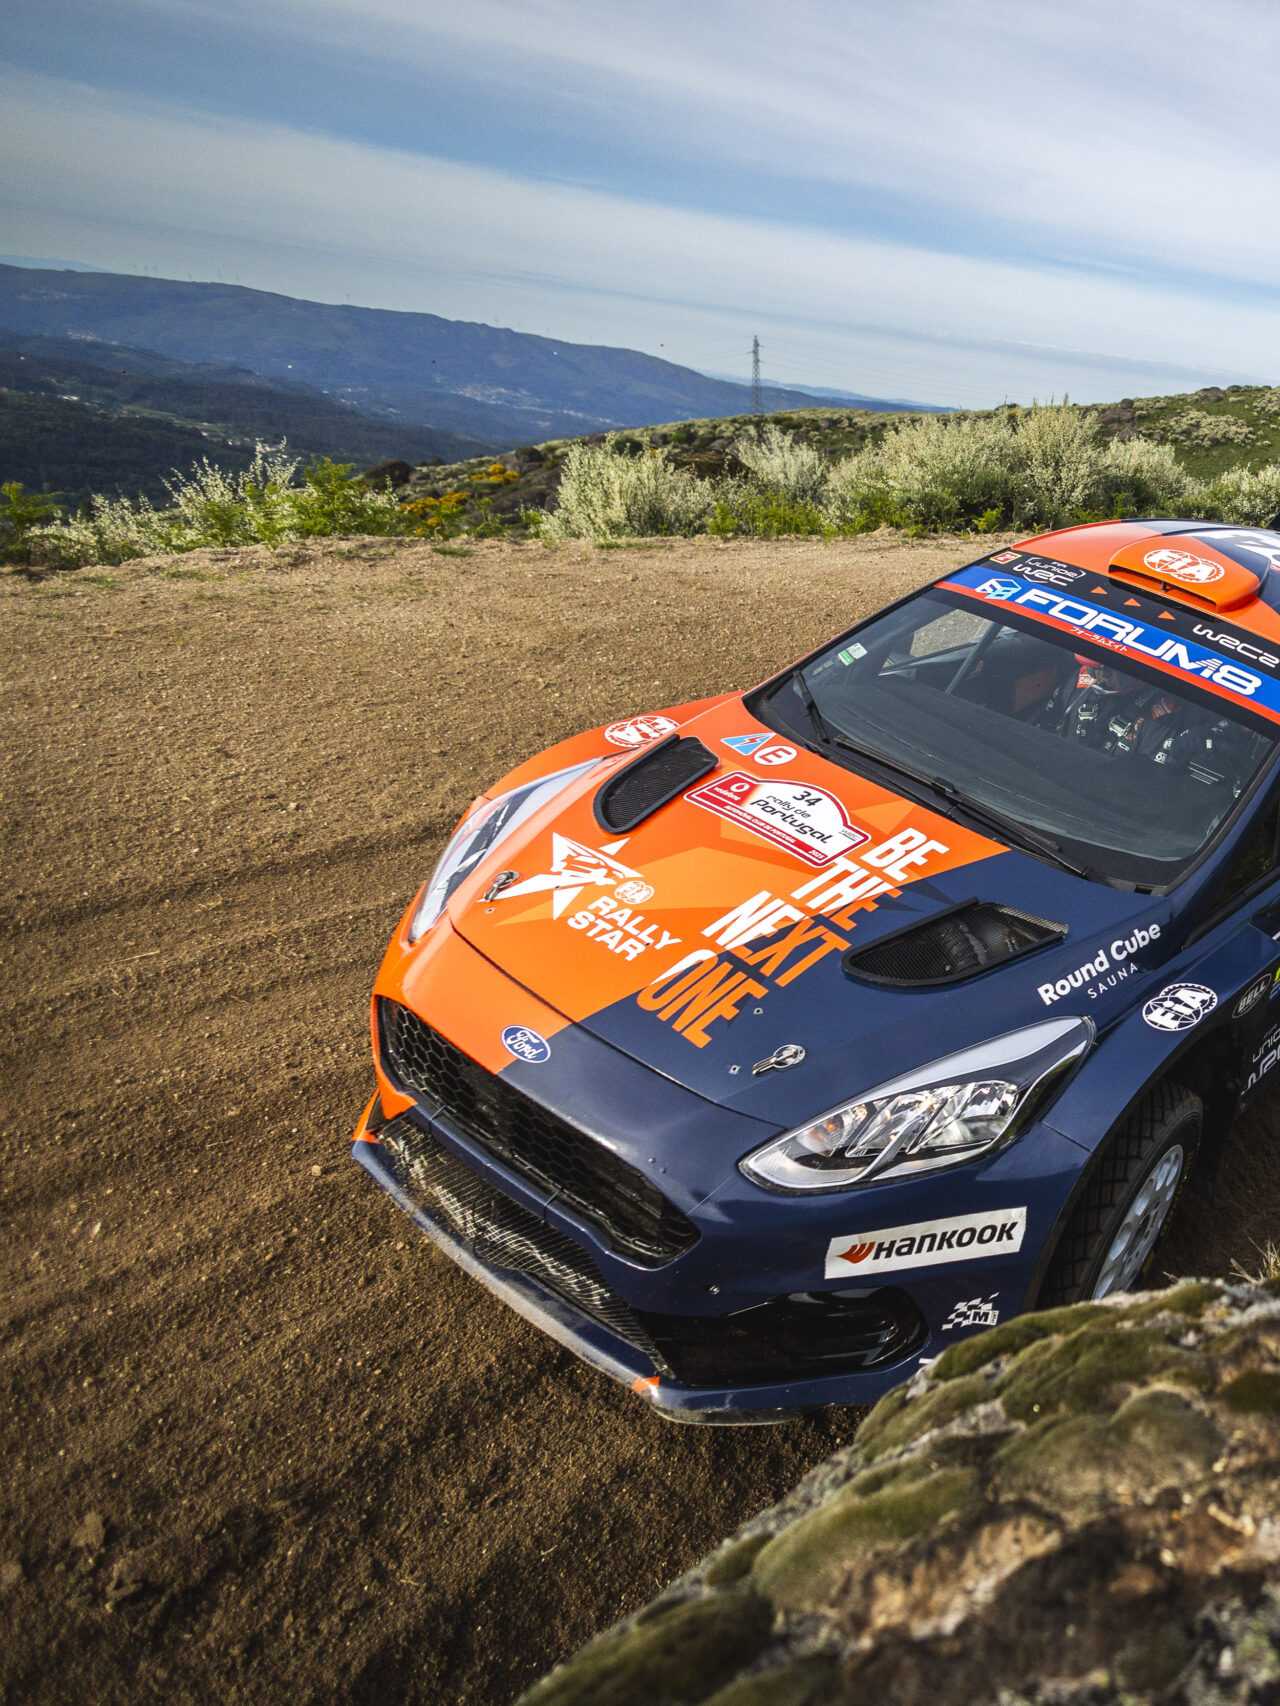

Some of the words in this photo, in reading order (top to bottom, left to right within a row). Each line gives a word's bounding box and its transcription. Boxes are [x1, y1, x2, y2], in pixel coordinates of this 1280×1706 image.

[1012, 563, 1075, 587] WRC
[1148, 549, 1213, 581] FIA
[1014, 588, 1263, 696] FORUM8
[1192, 623, 1280, 669] WRC2
[618, 717, 678, 744] FIA
[758, 747, 793, 763] E
[766, 795, 794, 812] rally
[793, 805, 811, 819] de
[792, 790, 823, 807] 34
[859, 827, 950, 882] BE
[790, 856, 904, 931] THE
[567, 910, 646, 961] STAR
[587, 895, 682, 950] RALLY
[700, 890, 852, 987] NEXT
[1036, 949, 1111, 1006] Round
[1110, 923, 1161, 961] Cube
[1087, 962, 1138, 999] SAUNA
[636, 949, 769, 1049] ONE
[1147, 988, 1209, 1030] FIA
[1237, 980, 1267, 1013] BELL
[506, 1030, 544, 1059] Ford
[972, 1311, 989, 1323] M
